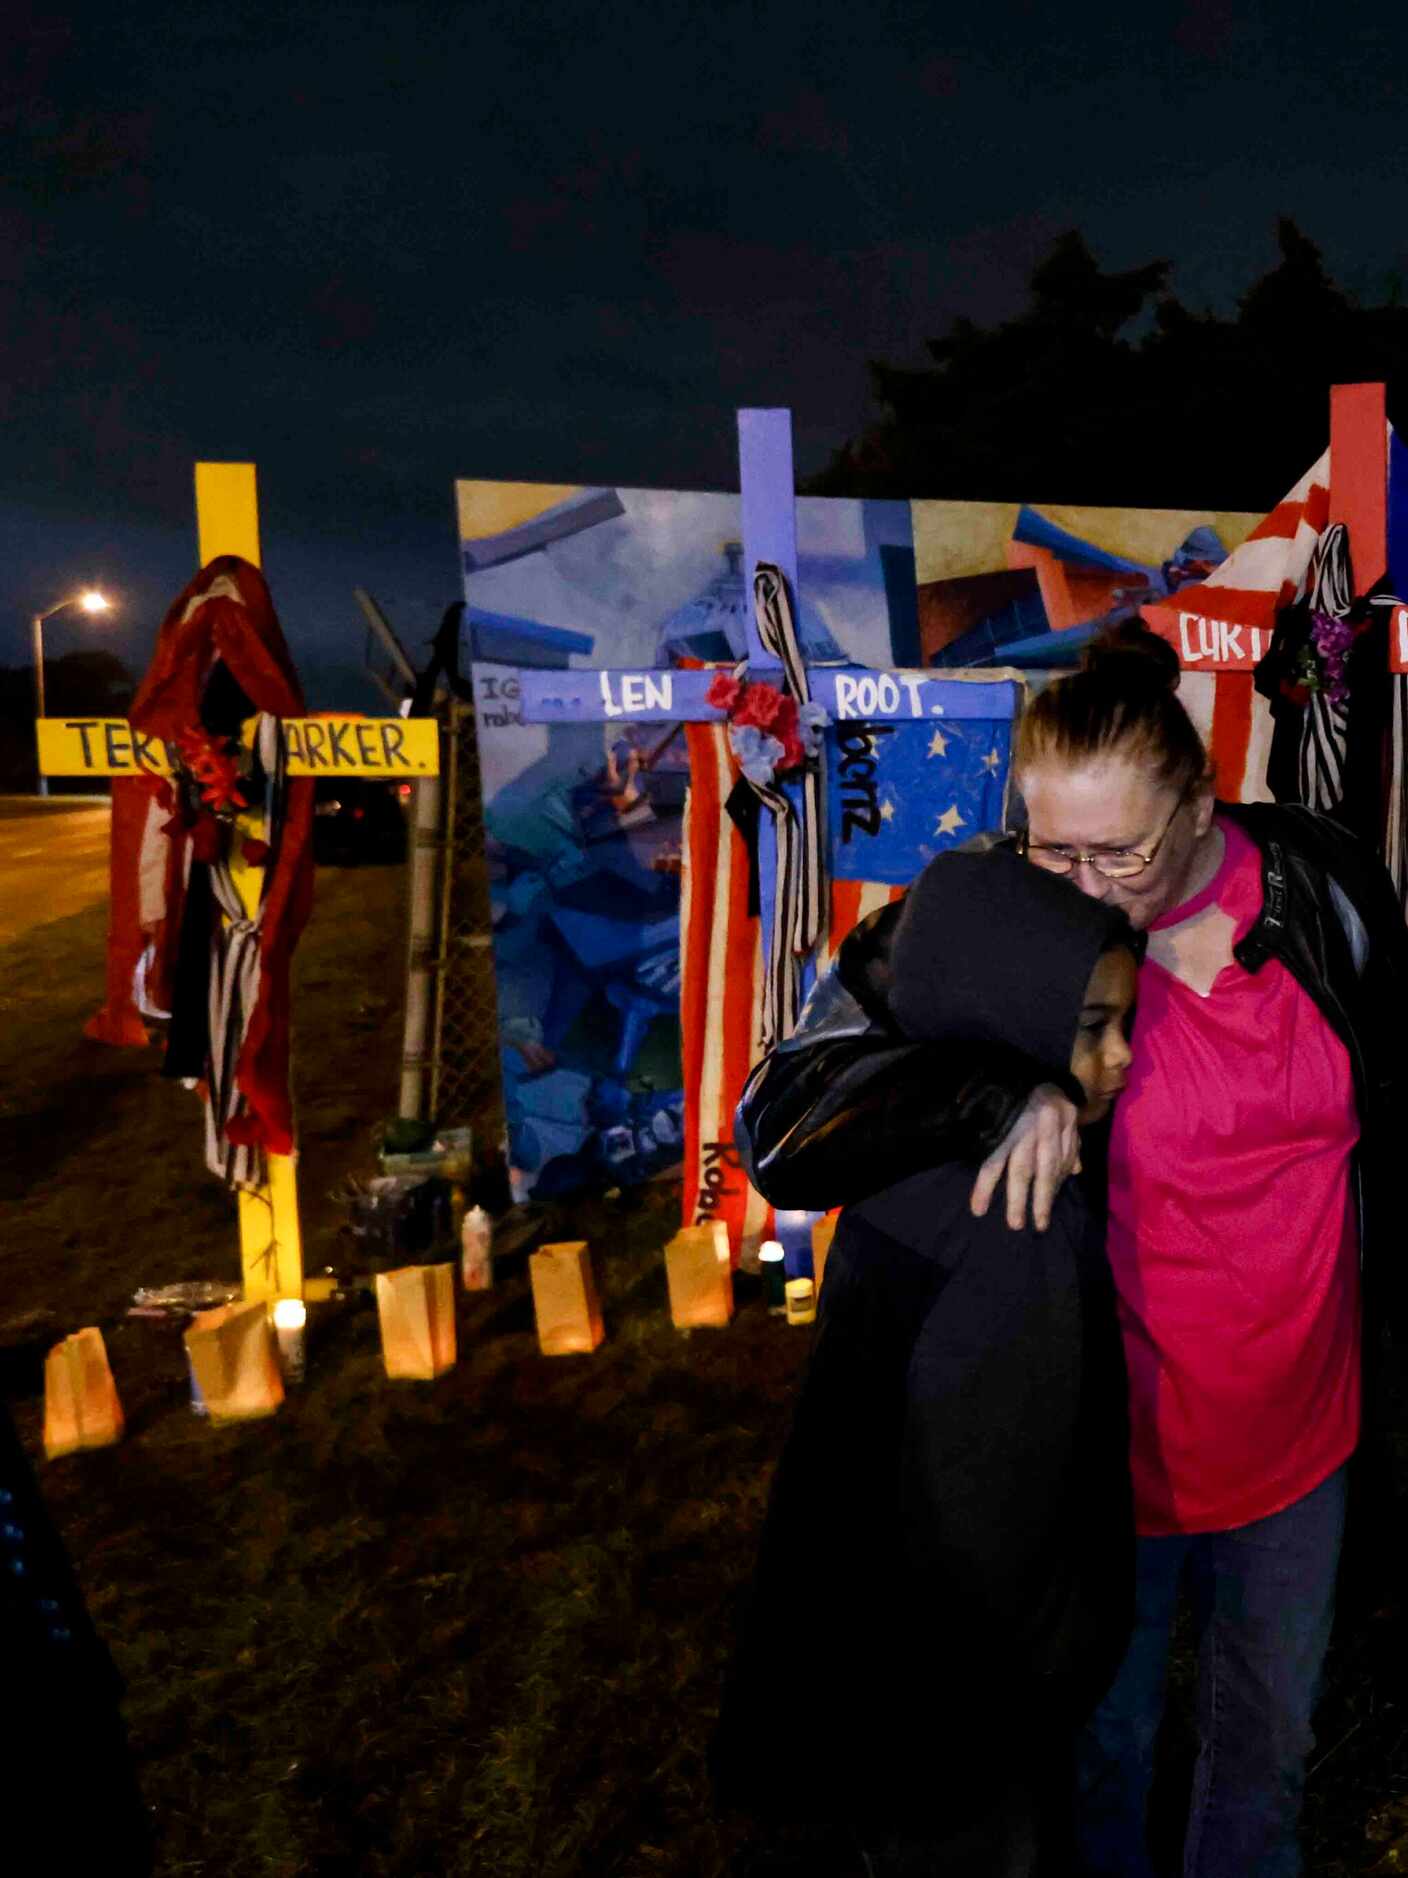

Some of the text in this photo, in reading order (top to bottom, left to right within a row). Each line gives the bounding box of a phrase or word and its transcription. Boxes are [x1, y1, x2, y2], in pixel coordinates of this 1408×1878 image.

[600, 670, 945, 719] LEN ROOT.
[272, 722, 427, 769] ARKER.
